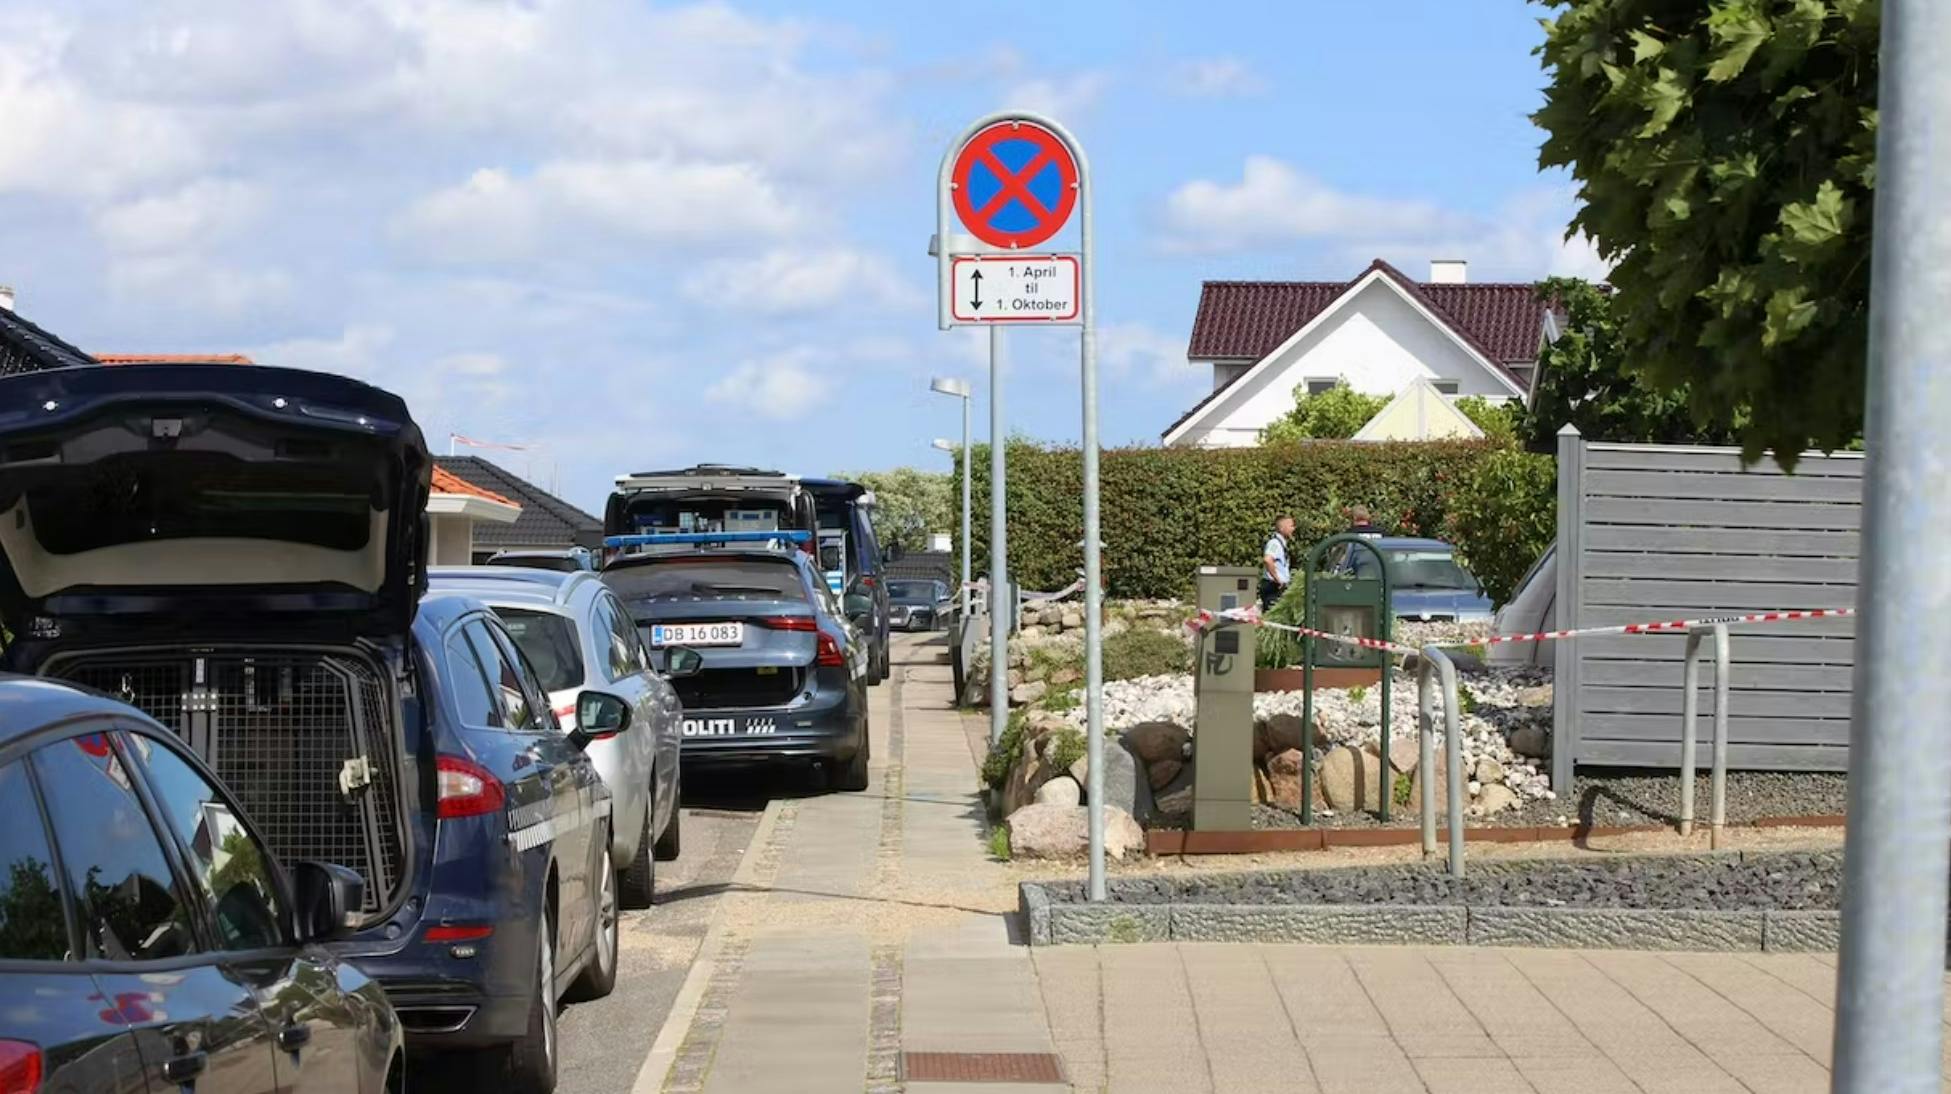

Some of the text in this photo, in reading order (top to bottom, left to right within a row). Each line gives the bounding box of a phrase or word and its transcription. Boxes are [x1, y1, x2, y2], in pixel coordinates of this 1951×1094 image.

[1008, 265, 1057, 280] 1. April
[1025, 282, 1038, 294] til
[997, 298, 1068, 311] 1. Oktober
[664, 625, 738, 641] DB 16 083
[682, 719, 735, 736] OLITI
